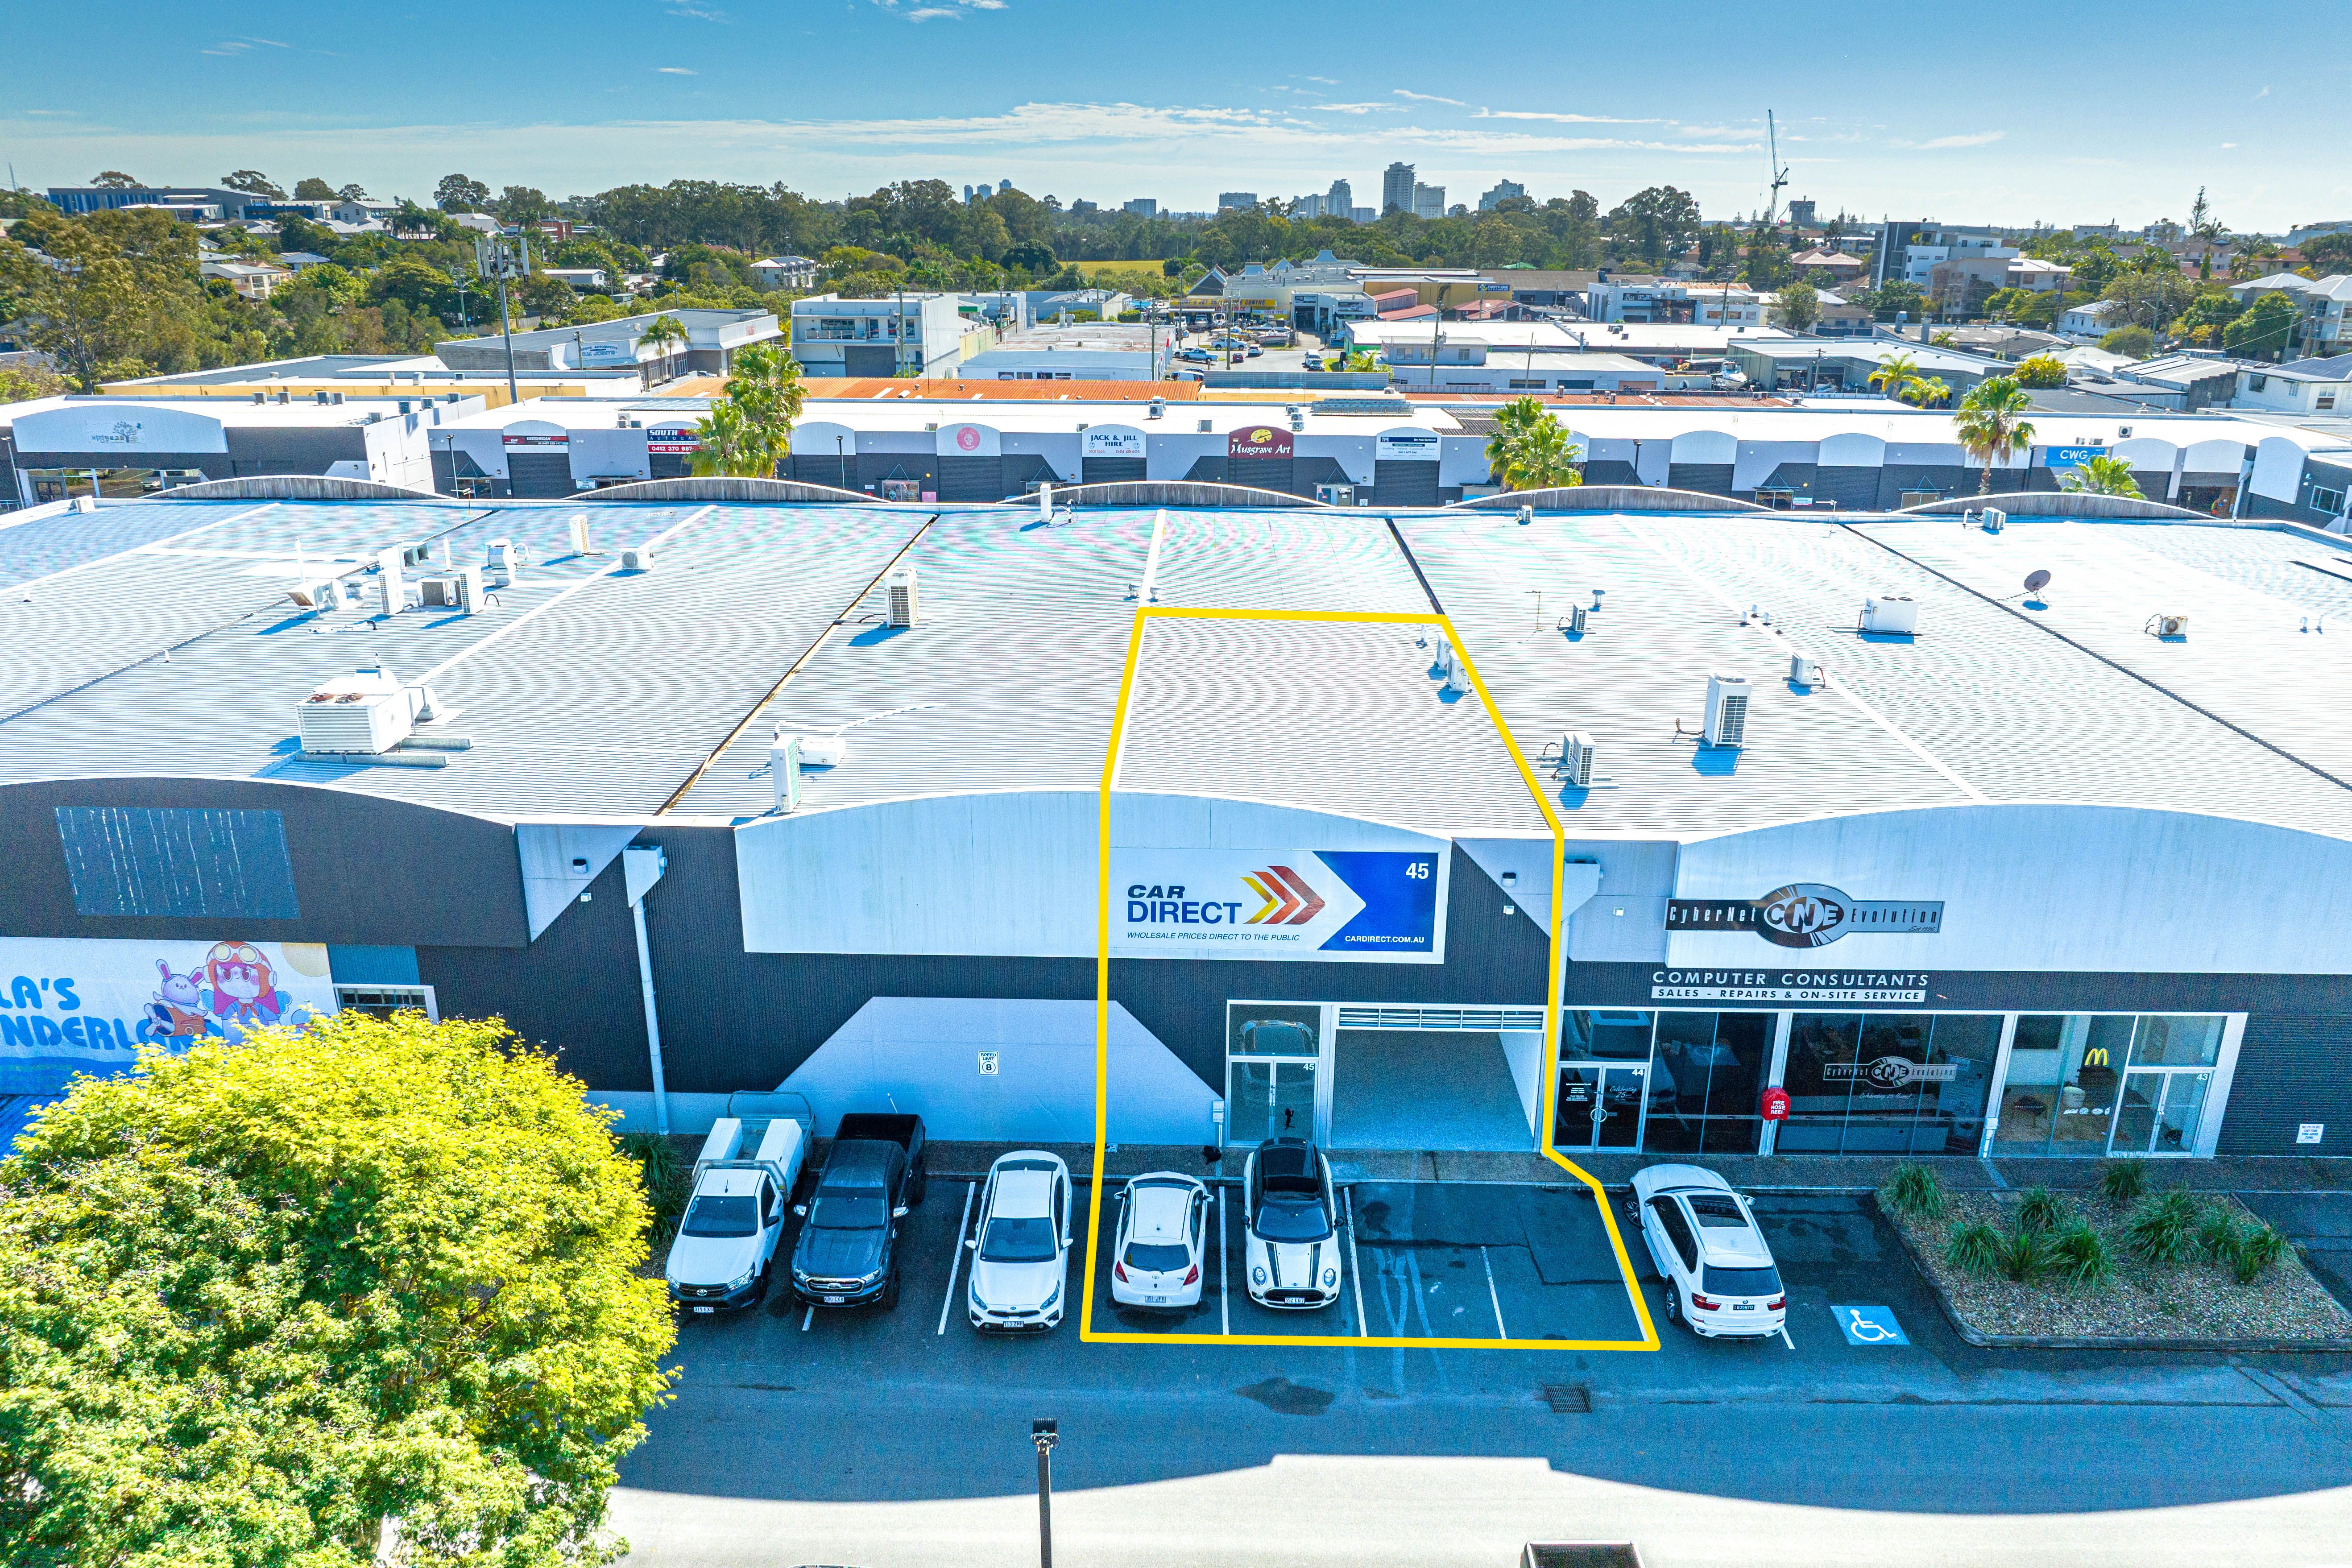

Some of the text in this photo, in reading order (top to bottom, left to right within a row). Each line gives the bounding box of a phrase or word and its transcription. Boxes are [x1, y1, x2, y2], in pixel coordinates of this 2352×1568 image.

[1230, 443, 1291, 455] Musgrave Art
[2060, 450, 2088, 459] CWG
[1405, 862, 1429, 879] 45
[1127, 885, 1185, 898] CAR
[1128, 901, 1242, 924] DIRECT
[1669, 903, 1937, 927] CyberNet CNE Evolution
[1652, 971, 1929, 986] COMPUTER CONSULTANTS
[1720, 990, 1776, 998] REPAIRS
[1864, 992, 1919, 1000] SERVICE
[1873, 1066, 1907, 1079] CNE
